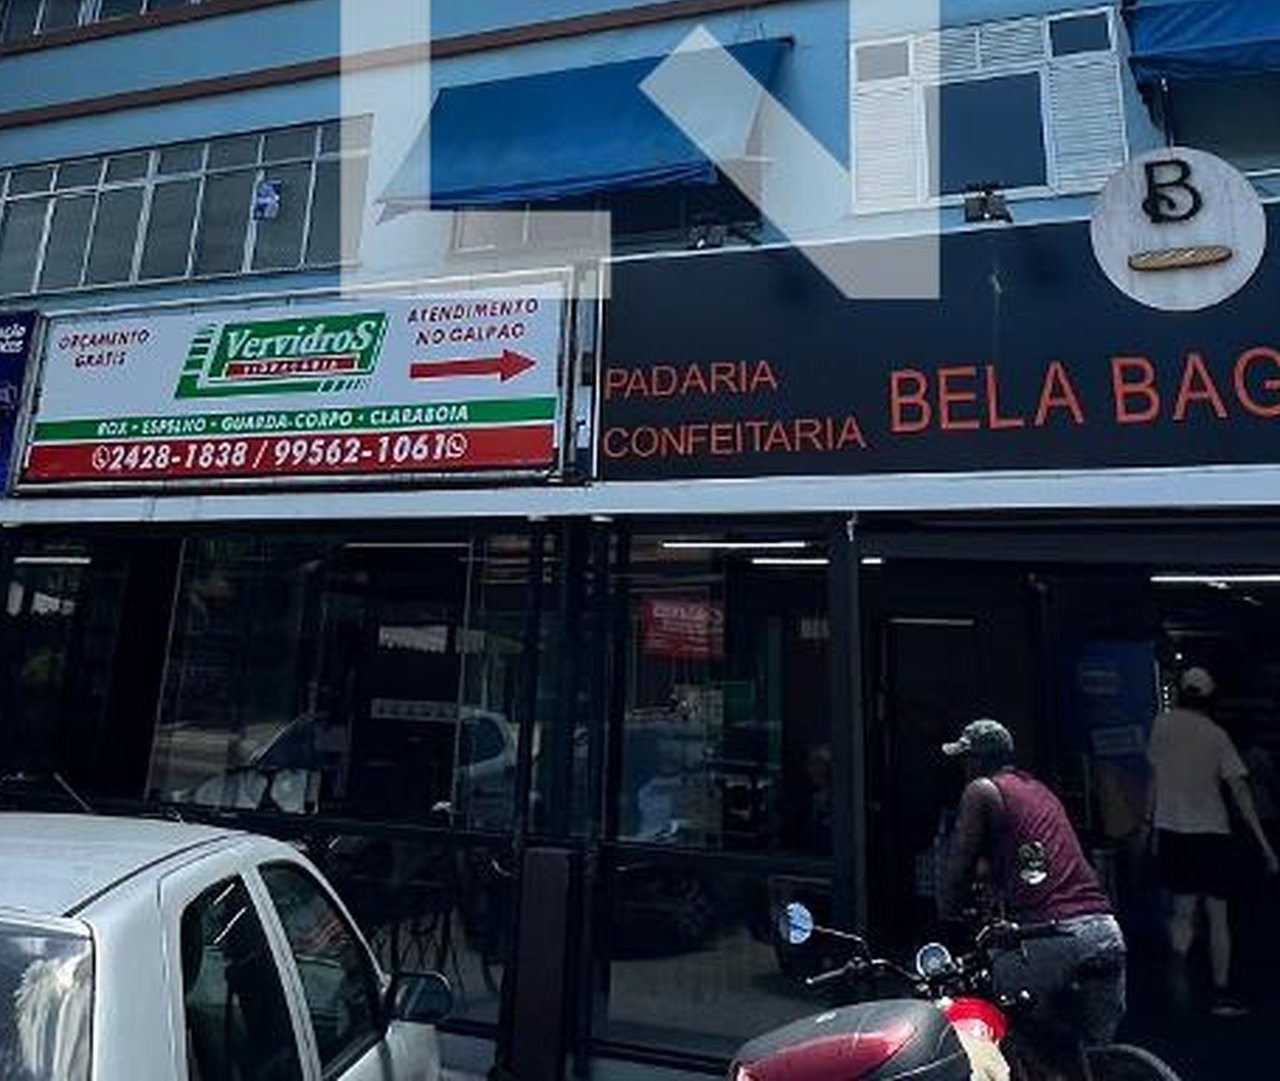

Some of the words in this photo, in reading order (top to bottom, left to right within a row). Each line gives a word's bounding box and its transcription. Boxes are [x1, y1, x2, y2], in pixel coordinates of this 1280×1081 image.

[1142, 158, 1202, 223] B
[407, 298, 539, 324] ATENDIMENTO
[58, 328, 151, 351] ORÇAMENTO
[416, 328, 445, 345] NO
[604, 359, 778, 401] PADARIA
[888, 360, 1086, 434] BELA
[221, 412, 353, 432] GUARDA-CORPO
[370, 405, 468, 426] CLARABOIA
[602, 416, 867, 459] CONFEITARIA
[108, 442, 248, 470] 2428-1838
[274, 432, 448, 466] 99562-1061
